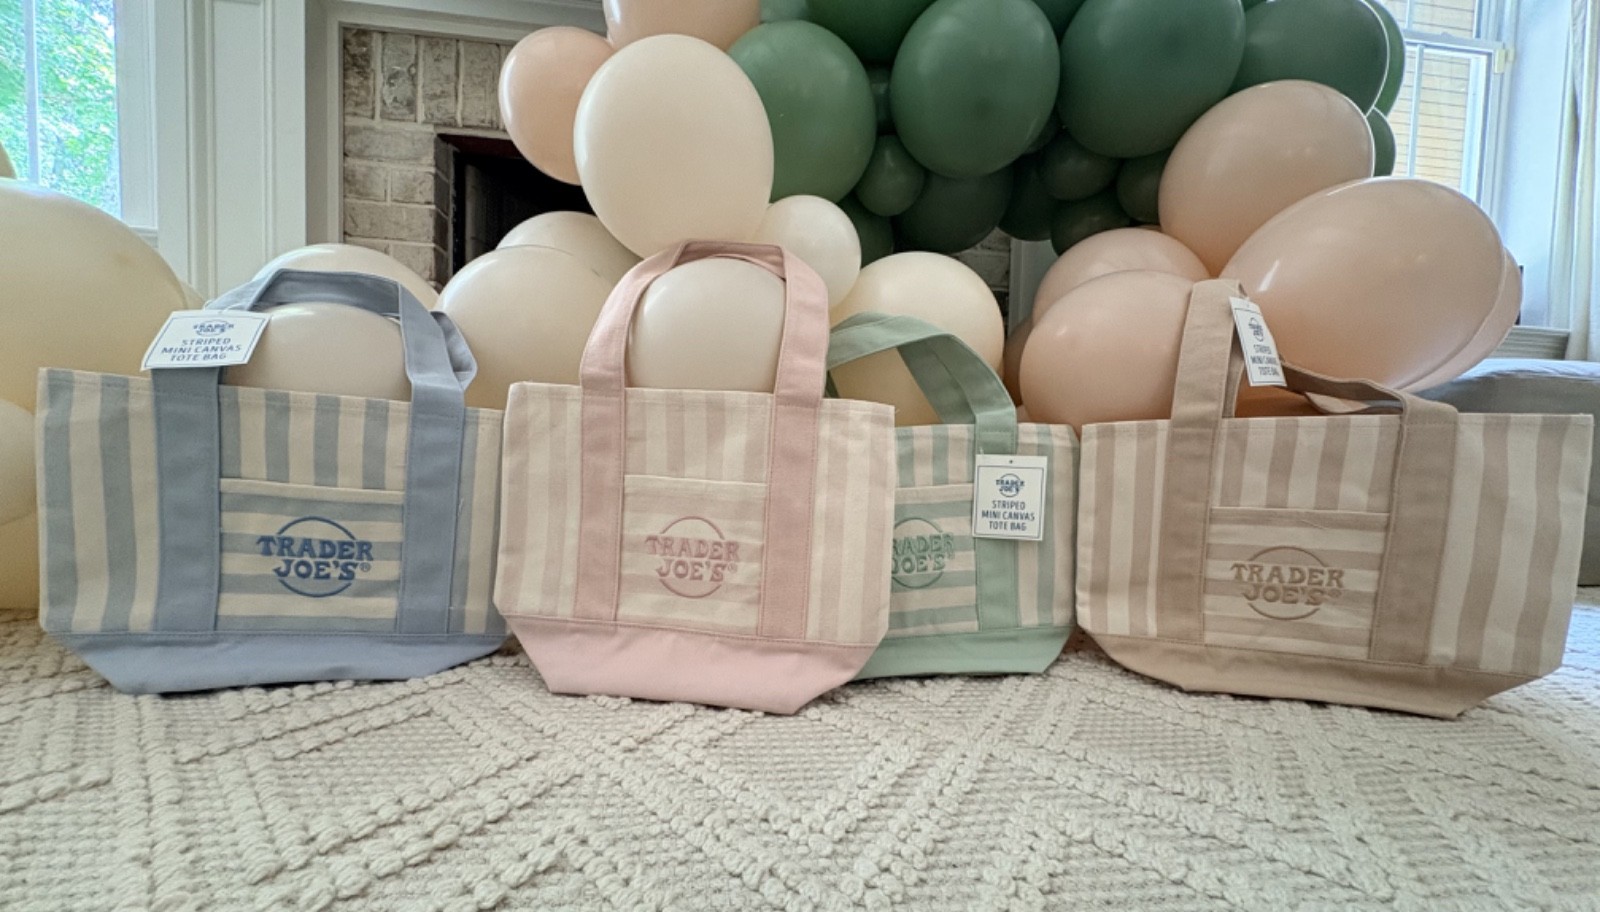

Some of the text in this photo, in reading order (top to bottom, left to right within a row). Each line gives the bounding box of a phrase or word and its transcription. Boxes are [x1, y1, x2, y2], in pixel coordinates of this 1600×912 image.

[194, 345, 241, 353] CANVAS
[992, 500, 1026, 511] STRIPED
[982, 510, 1035, 521] MINI CANVAS
[989, 521, 1027, 532] TOTE BAG
[256, 535, 374, 562] TRADER
[644, 534, 740, 562] TRADER
[1230, 563, 1345, 588] TRADER
